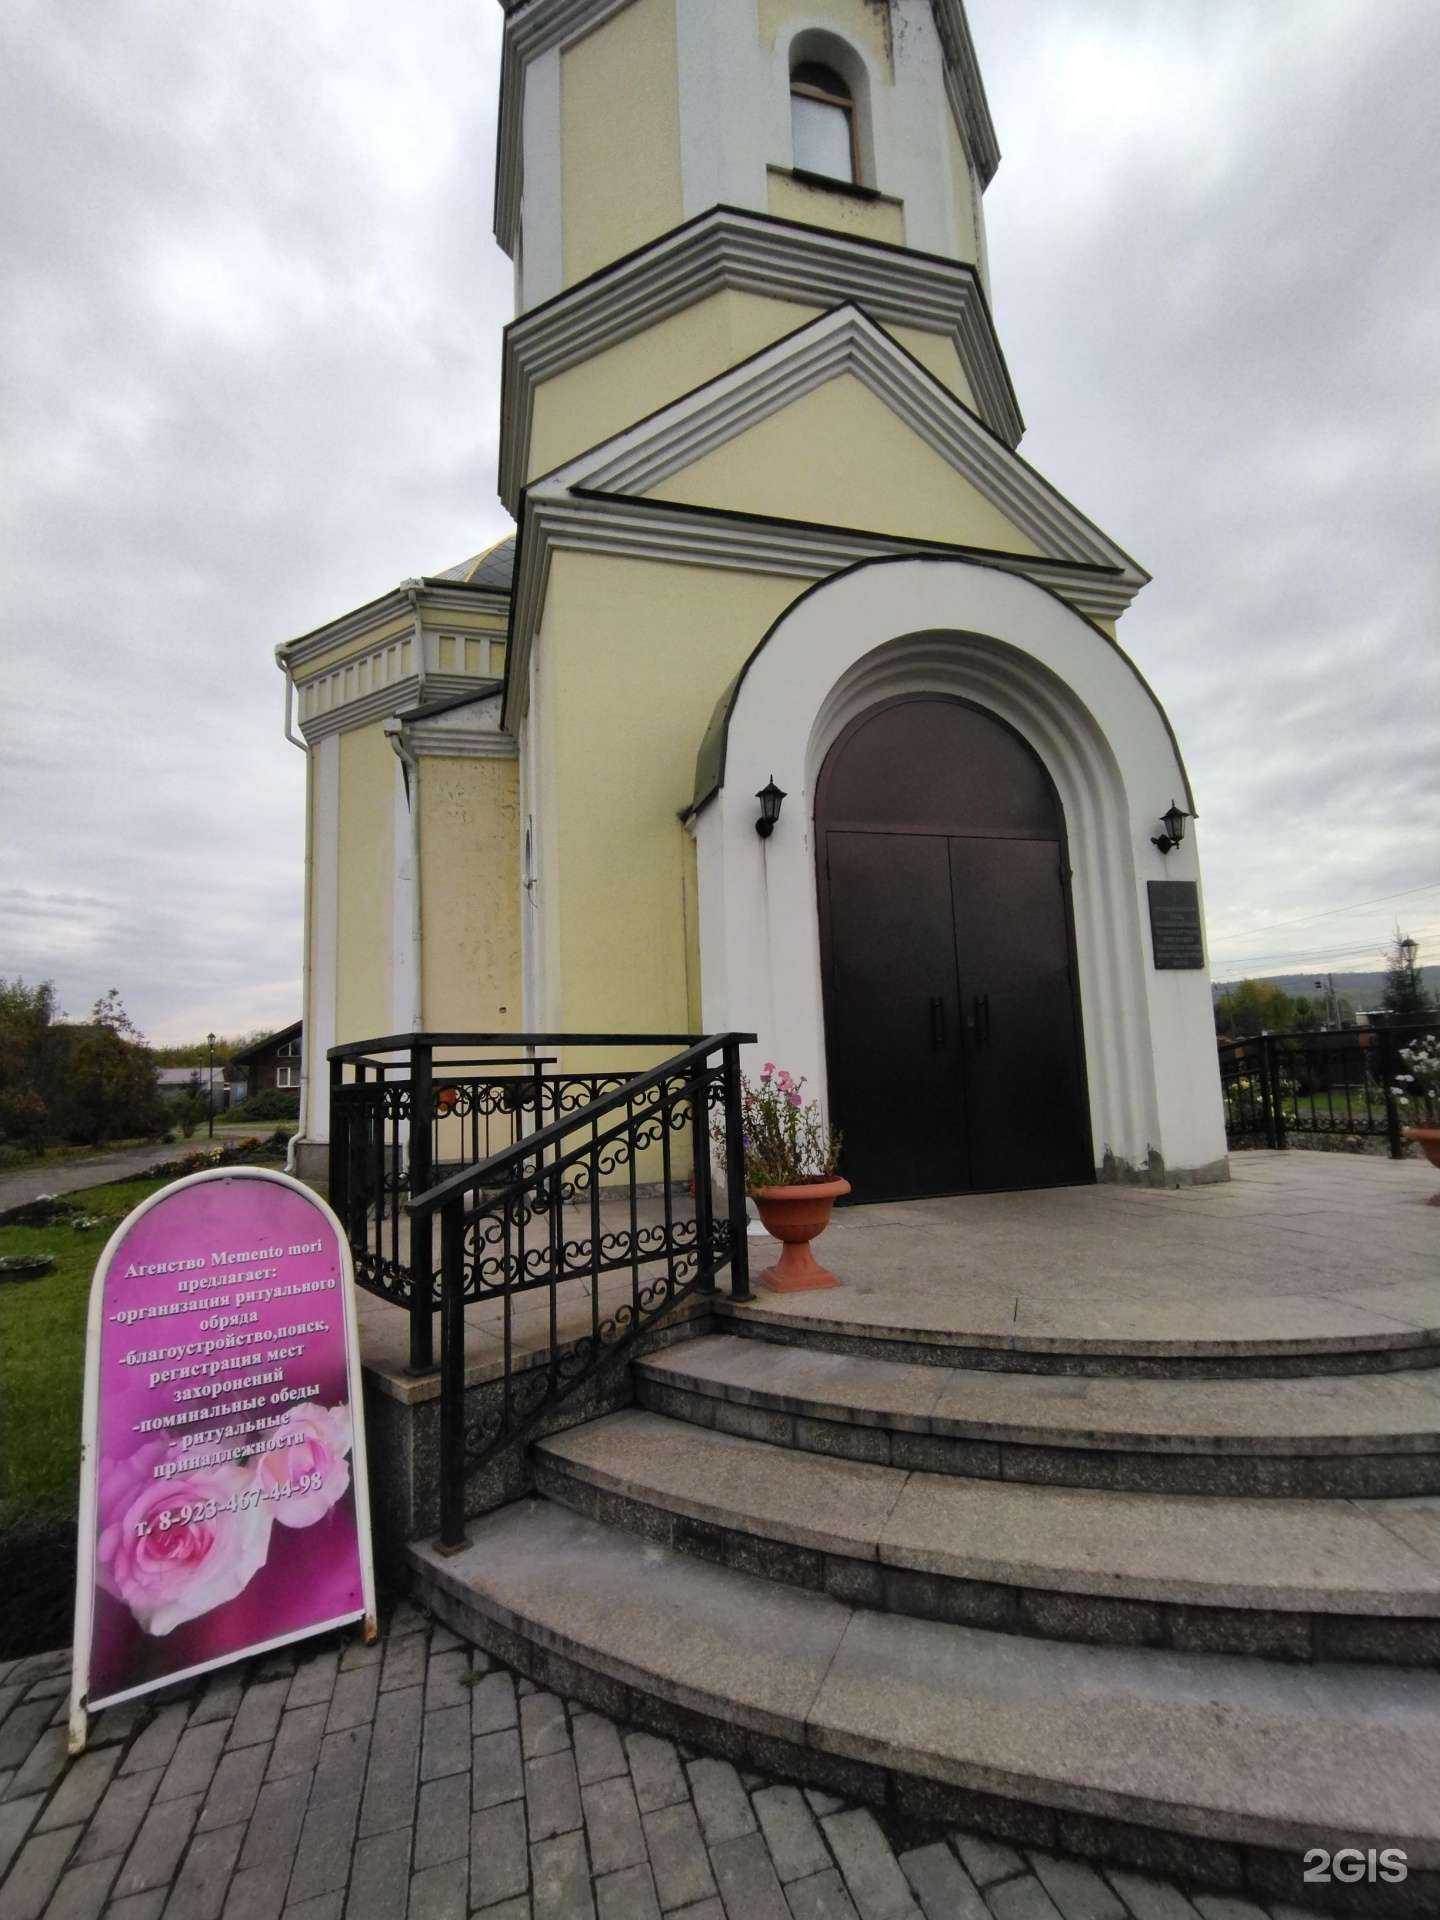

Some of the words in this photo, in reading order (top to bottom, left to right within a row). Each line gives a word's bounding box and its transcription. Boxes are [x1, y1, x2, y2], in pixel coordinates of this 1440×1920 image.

[124, 1257, 205, 1279] Агенство
[210, 1247, 283, 1268] Memento
[288, 1239, 322, 1256] mori
[178, 1267, 278, 1293] предлагает:
[235, 1278, 336, 1306] ритуального
[199, 1311, 259, 1332] обряда
[149, 1352, 263, 1388] регистрация
[267, 1344, 305, 1362] мест
[173, 1367, 284, 1402] захоронений
[270, 1383, 320, 1404] обеды
[182, 1412, 290, 1450] ритуальные
[153, 1431, 305, 1479] принадлежности
[158, 1472, 323, 1531] 8-923-467-44-98
